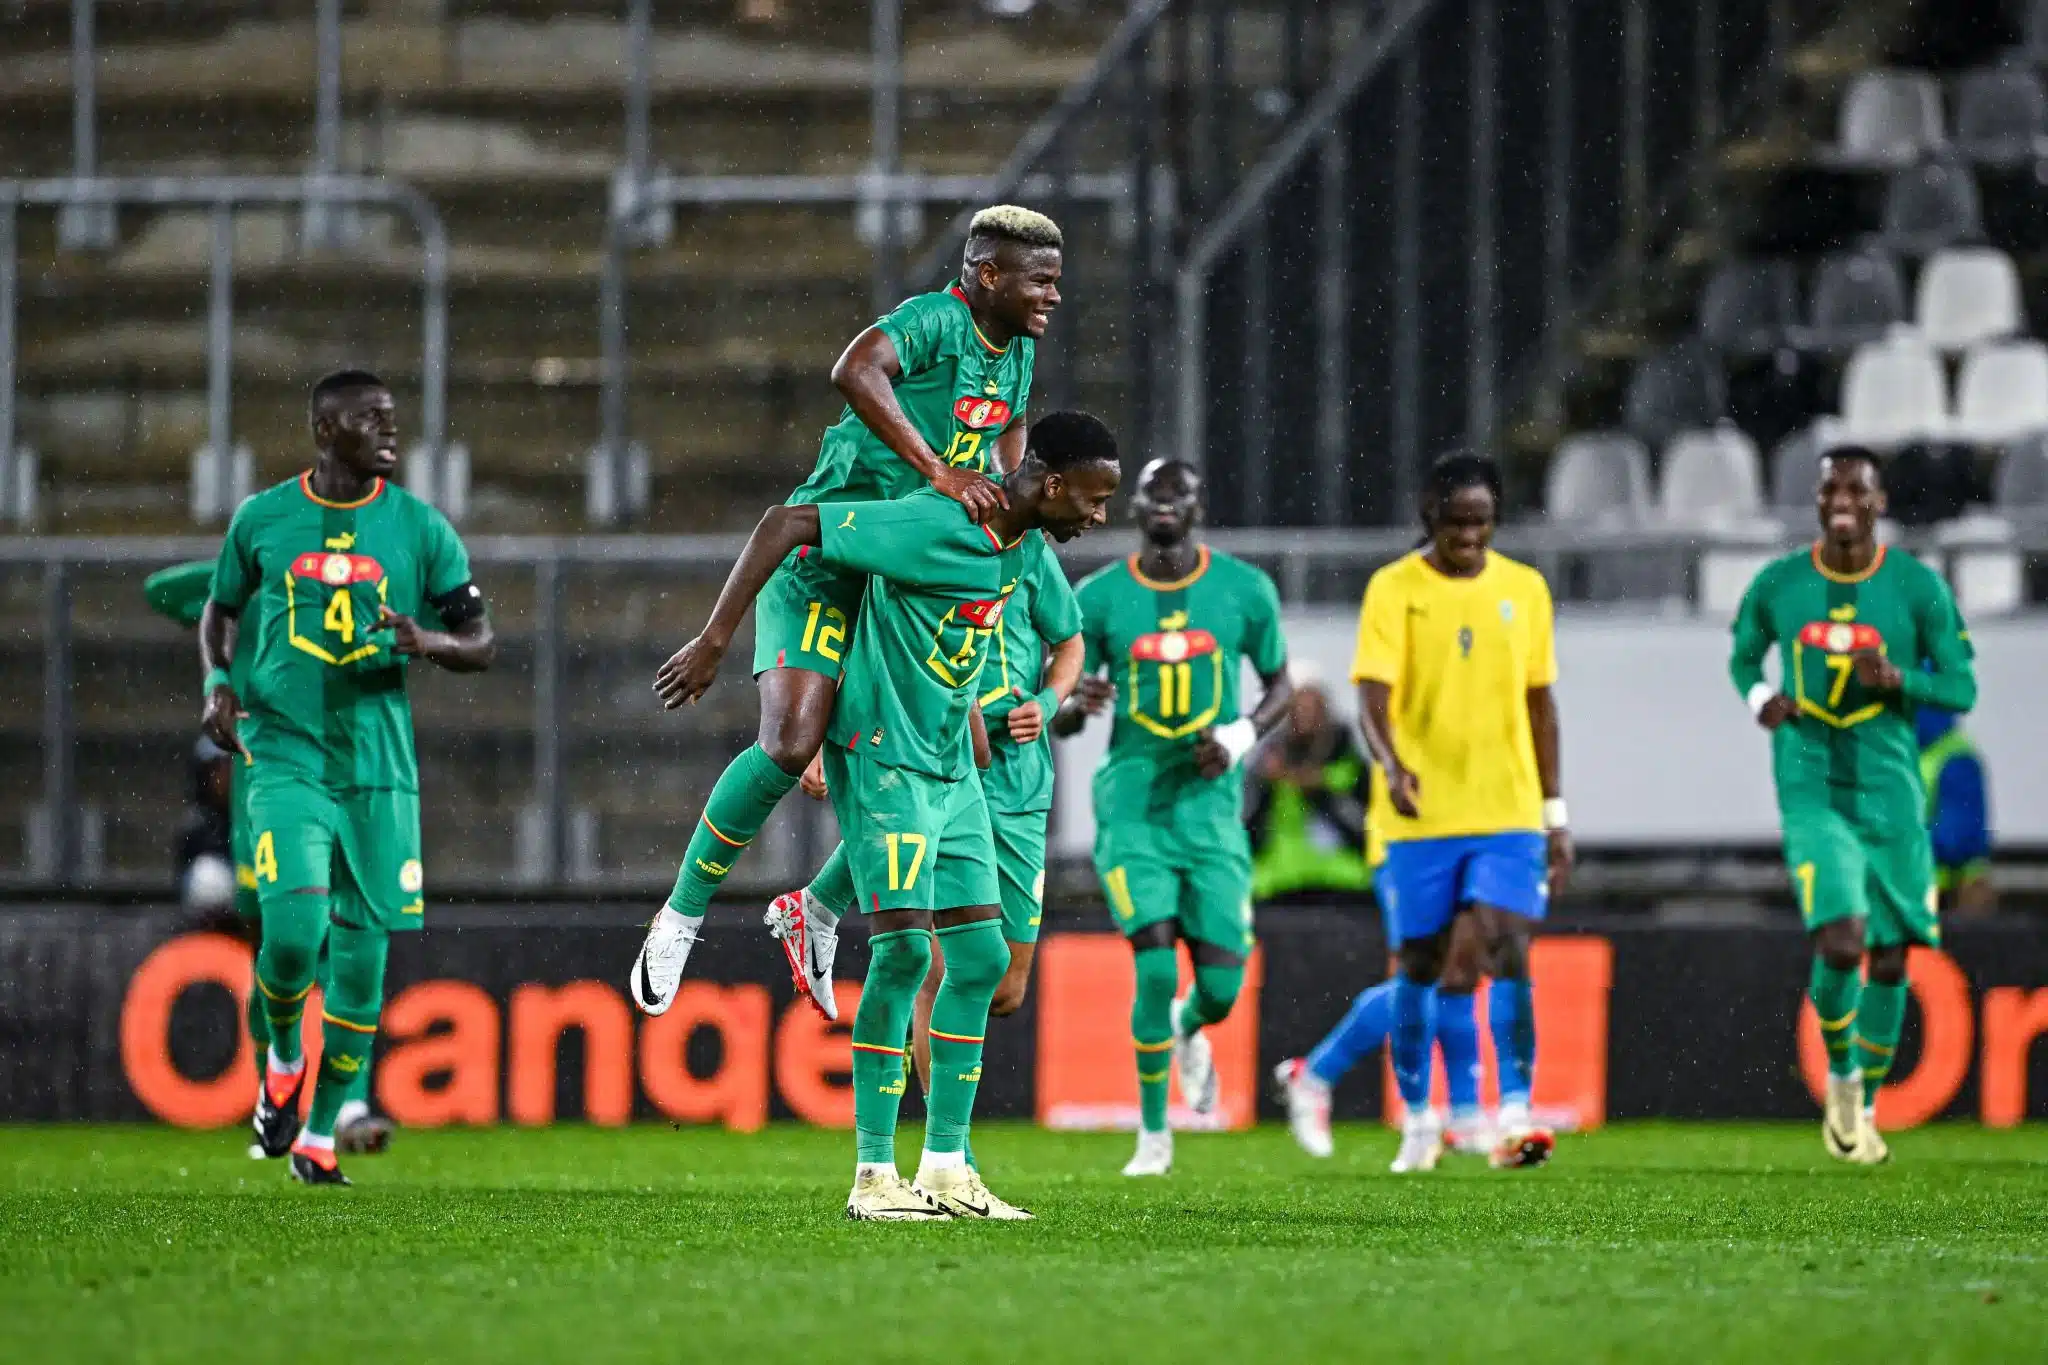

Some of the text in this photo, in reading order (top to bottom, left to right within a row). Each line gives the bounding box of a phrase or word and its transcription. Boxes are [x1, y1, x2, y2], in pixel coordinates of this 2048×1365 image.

[950, 431, 982, 468] 12
[324, 588, 355, 643] 4
[800, 602, 846, 664] 12
[1457, 624, 1473, 660] 9
[1158, 662, 1191, 718] 11
[1826, 654, 1853, 708] 7
[255, 831, 278, 883] 4
[885, 833, 927, 891] 17
